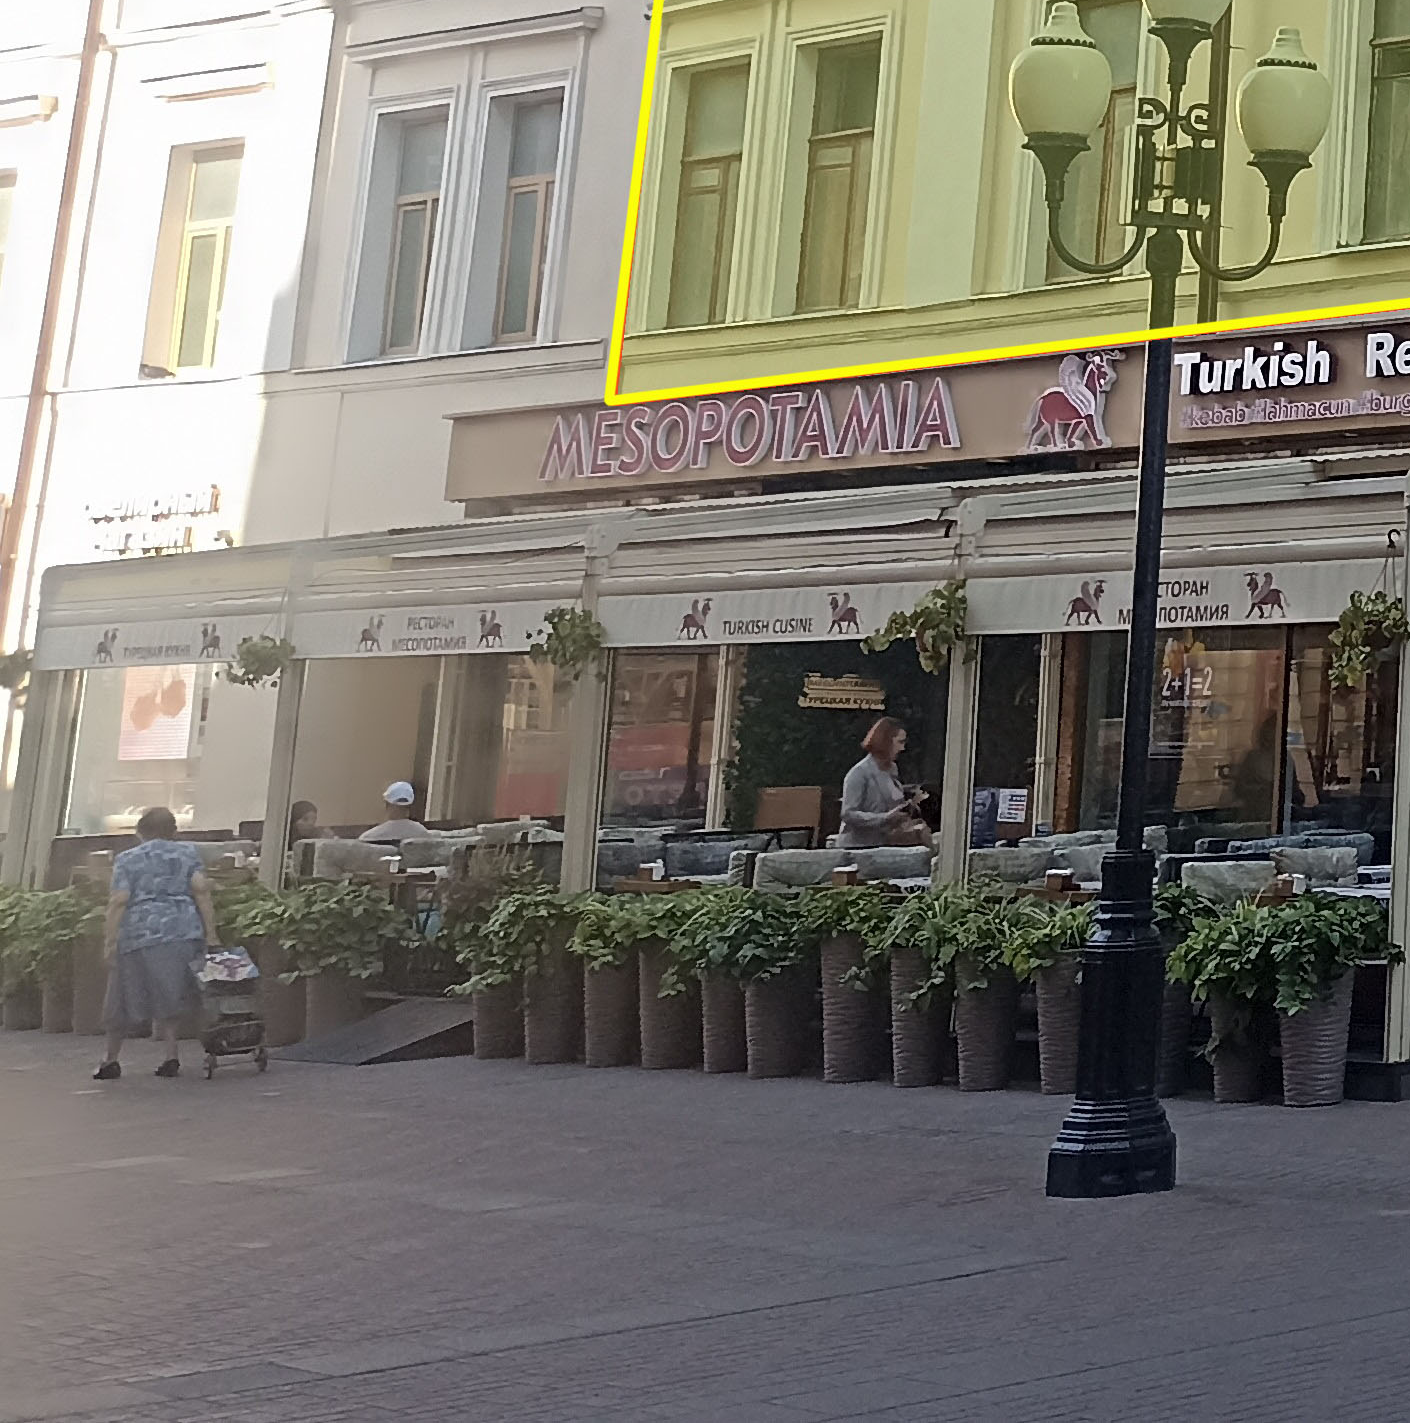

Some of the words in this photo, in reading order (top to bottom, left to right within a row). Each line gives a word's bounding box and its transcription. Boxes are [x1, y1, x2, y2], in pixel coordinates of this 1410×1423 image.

[1173, 340, 1331, 396] Turkish
[1250, 397, 1351, 423] #lahmacun
[538, 377, 961, 480] MESOPOTAMIA
[1157, 580, 1210, 598] СТОРАН
[407, 616, 455, 630] РЕСТОРАН
[723, 619, 769, 636] TURKISH
[772, 617, 814, 634] CUSINE
[1118, 603, 1229, 626] МПОТАМИЯ
[1162, 666, 1213, 697] 2+1=2
